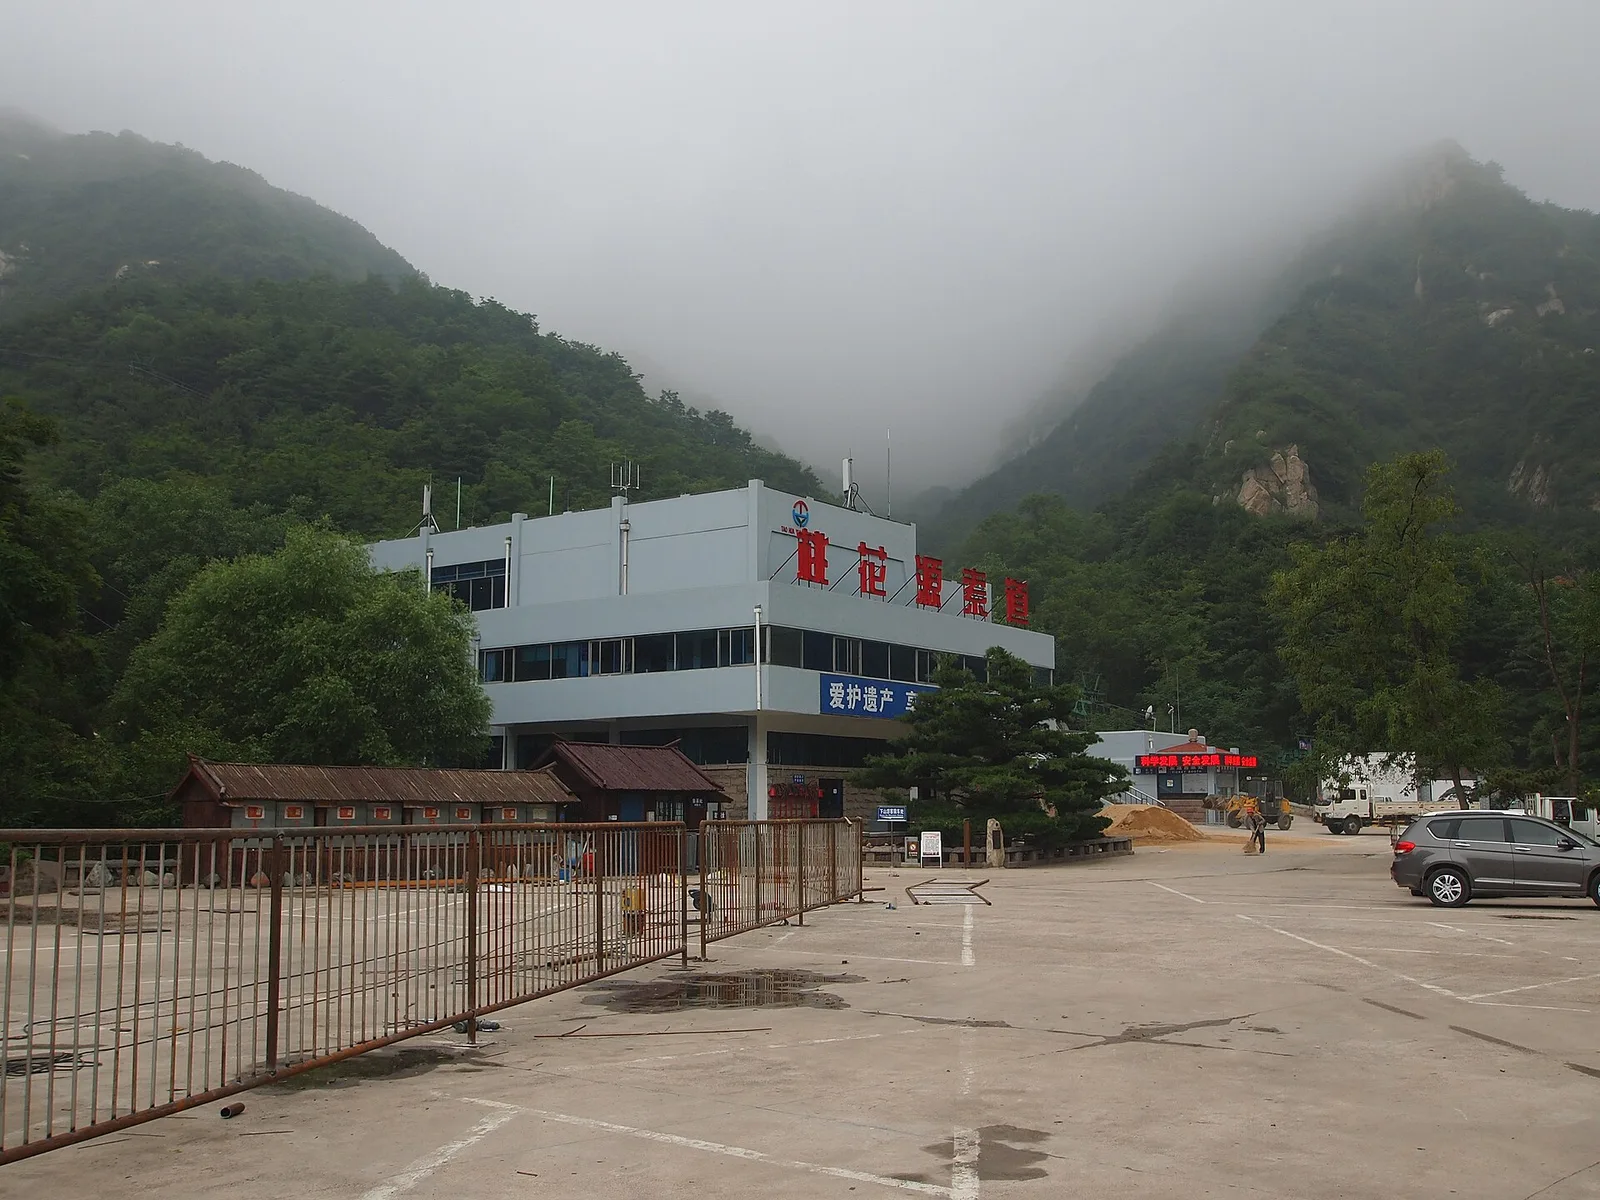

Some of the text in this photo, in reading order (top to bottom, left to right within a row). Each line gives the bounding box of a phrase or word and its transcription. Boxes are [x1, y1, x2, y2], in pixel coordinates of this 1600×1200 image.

[829, 682, 894, 713] 爱护遗产
[1182, 754, 1221, 766] 安全发展
